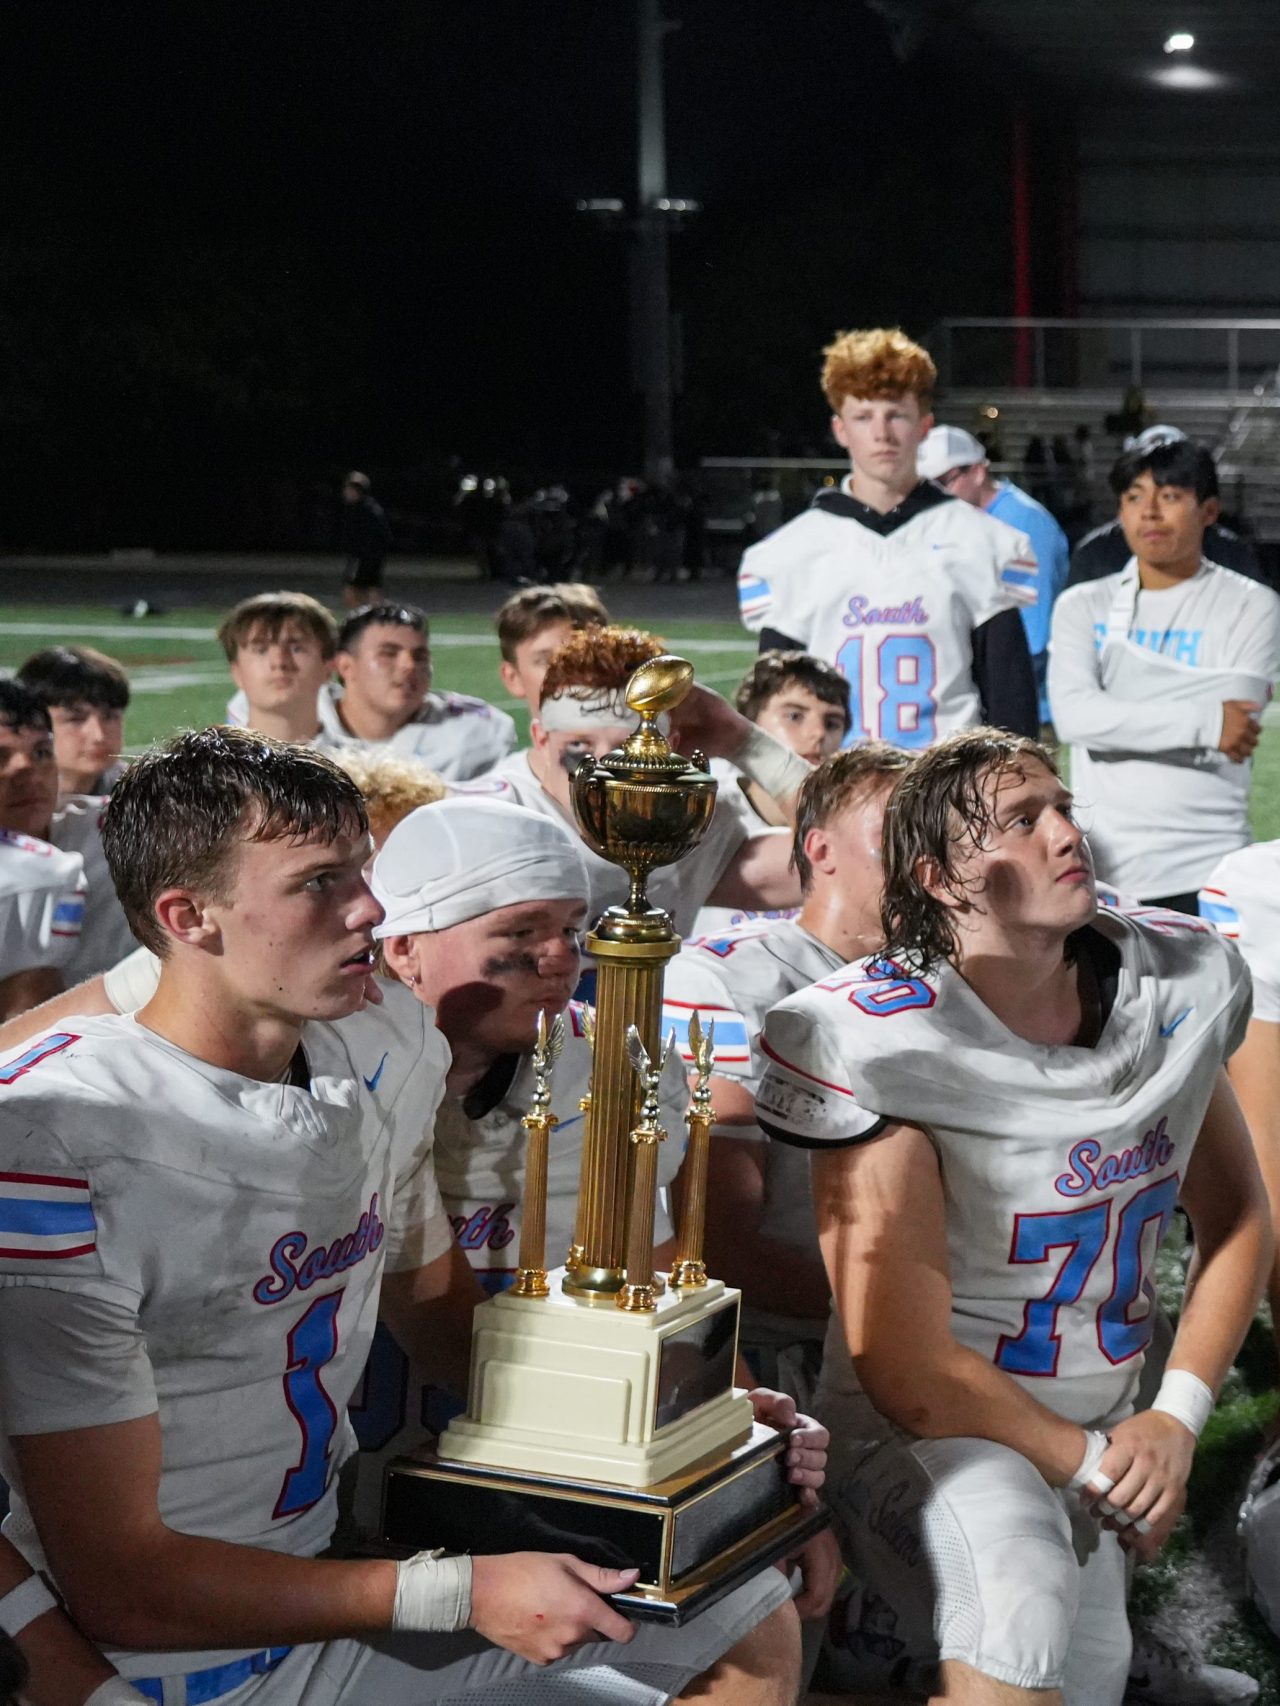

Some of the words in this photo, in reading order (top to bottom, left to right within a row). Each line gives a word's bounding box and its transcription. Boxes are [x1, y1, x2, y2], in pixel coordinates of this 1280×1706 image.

[842, 595, 929, 627] South
[834, 632, 938, 751] 18
[1054, 1116, 1175, 1198] South
[253, 1192, 384, 1305] South
[994, 1171, 1179, 1377] 70
[271, 1287, 346, 1520] 1
